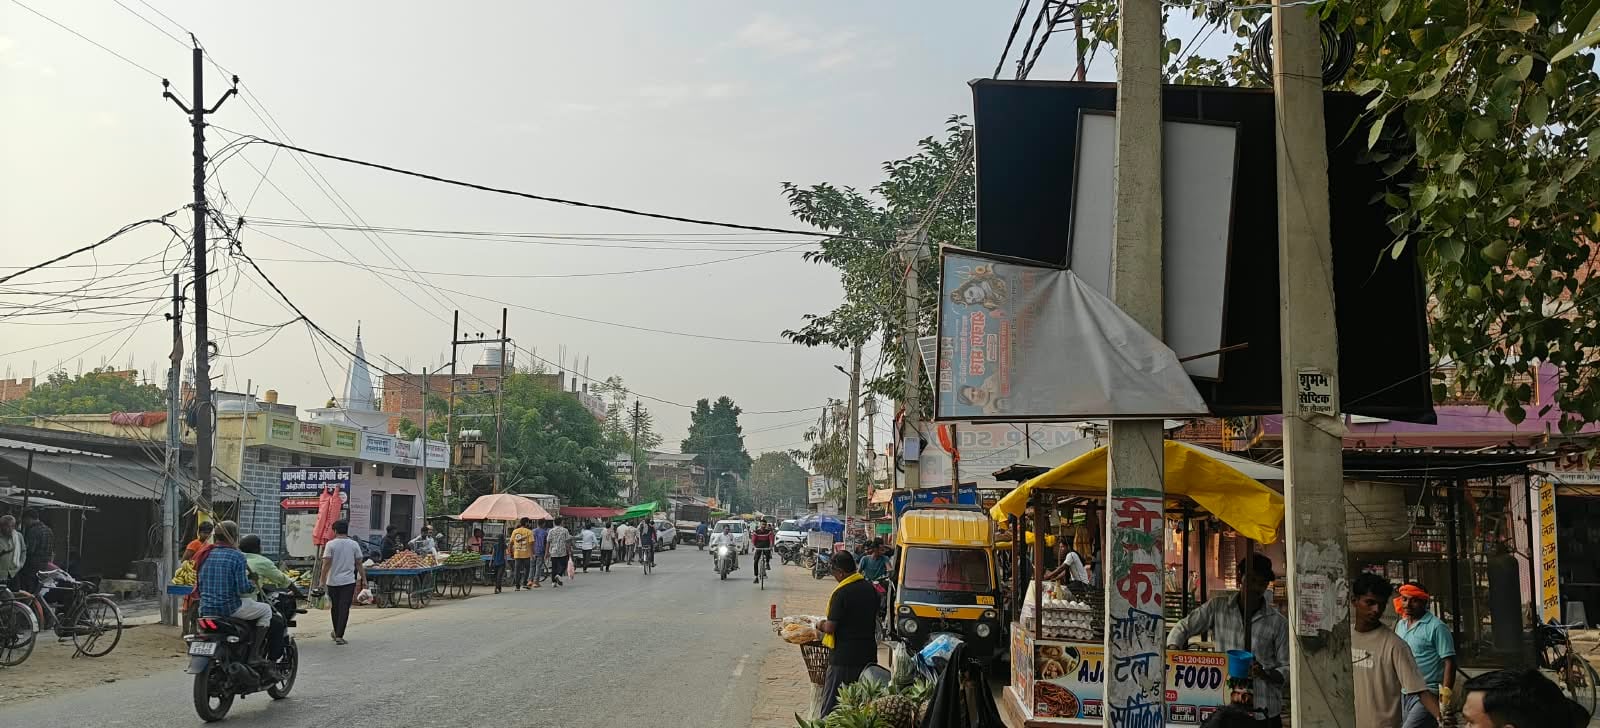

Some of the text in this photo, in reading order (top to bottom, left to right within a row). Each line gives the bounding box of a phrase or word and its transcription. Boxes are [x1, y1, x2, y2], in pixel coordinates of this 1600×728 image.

[282, 469, 307, 481] प्रधानमंत्री
[307, 471, 318, 481] जन
[1174, 665, 1223, 689] FOOD
